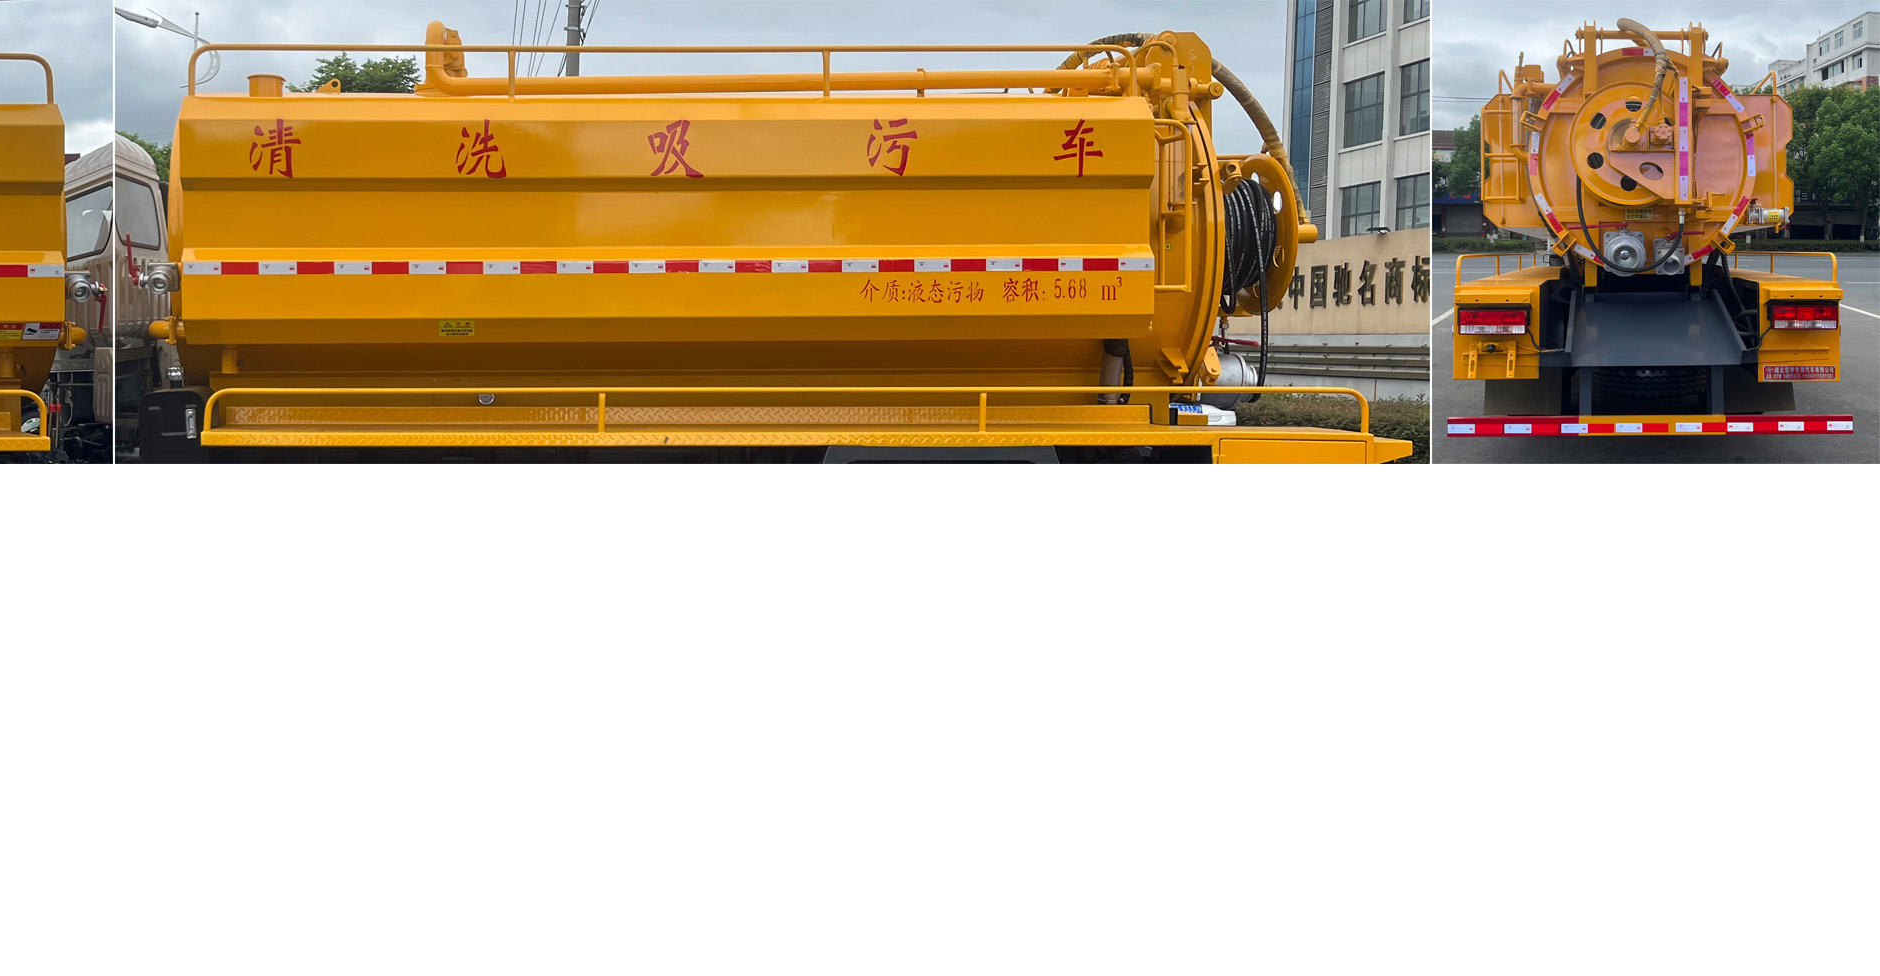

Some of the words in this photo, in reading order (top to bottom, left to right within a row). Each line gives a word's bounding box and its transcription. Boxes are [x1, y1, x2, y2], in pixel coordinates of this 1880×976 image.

[860, 278, 985, 304] 介质:液态污物
[1277, 255, 1430, 311] 中国驰名商标
